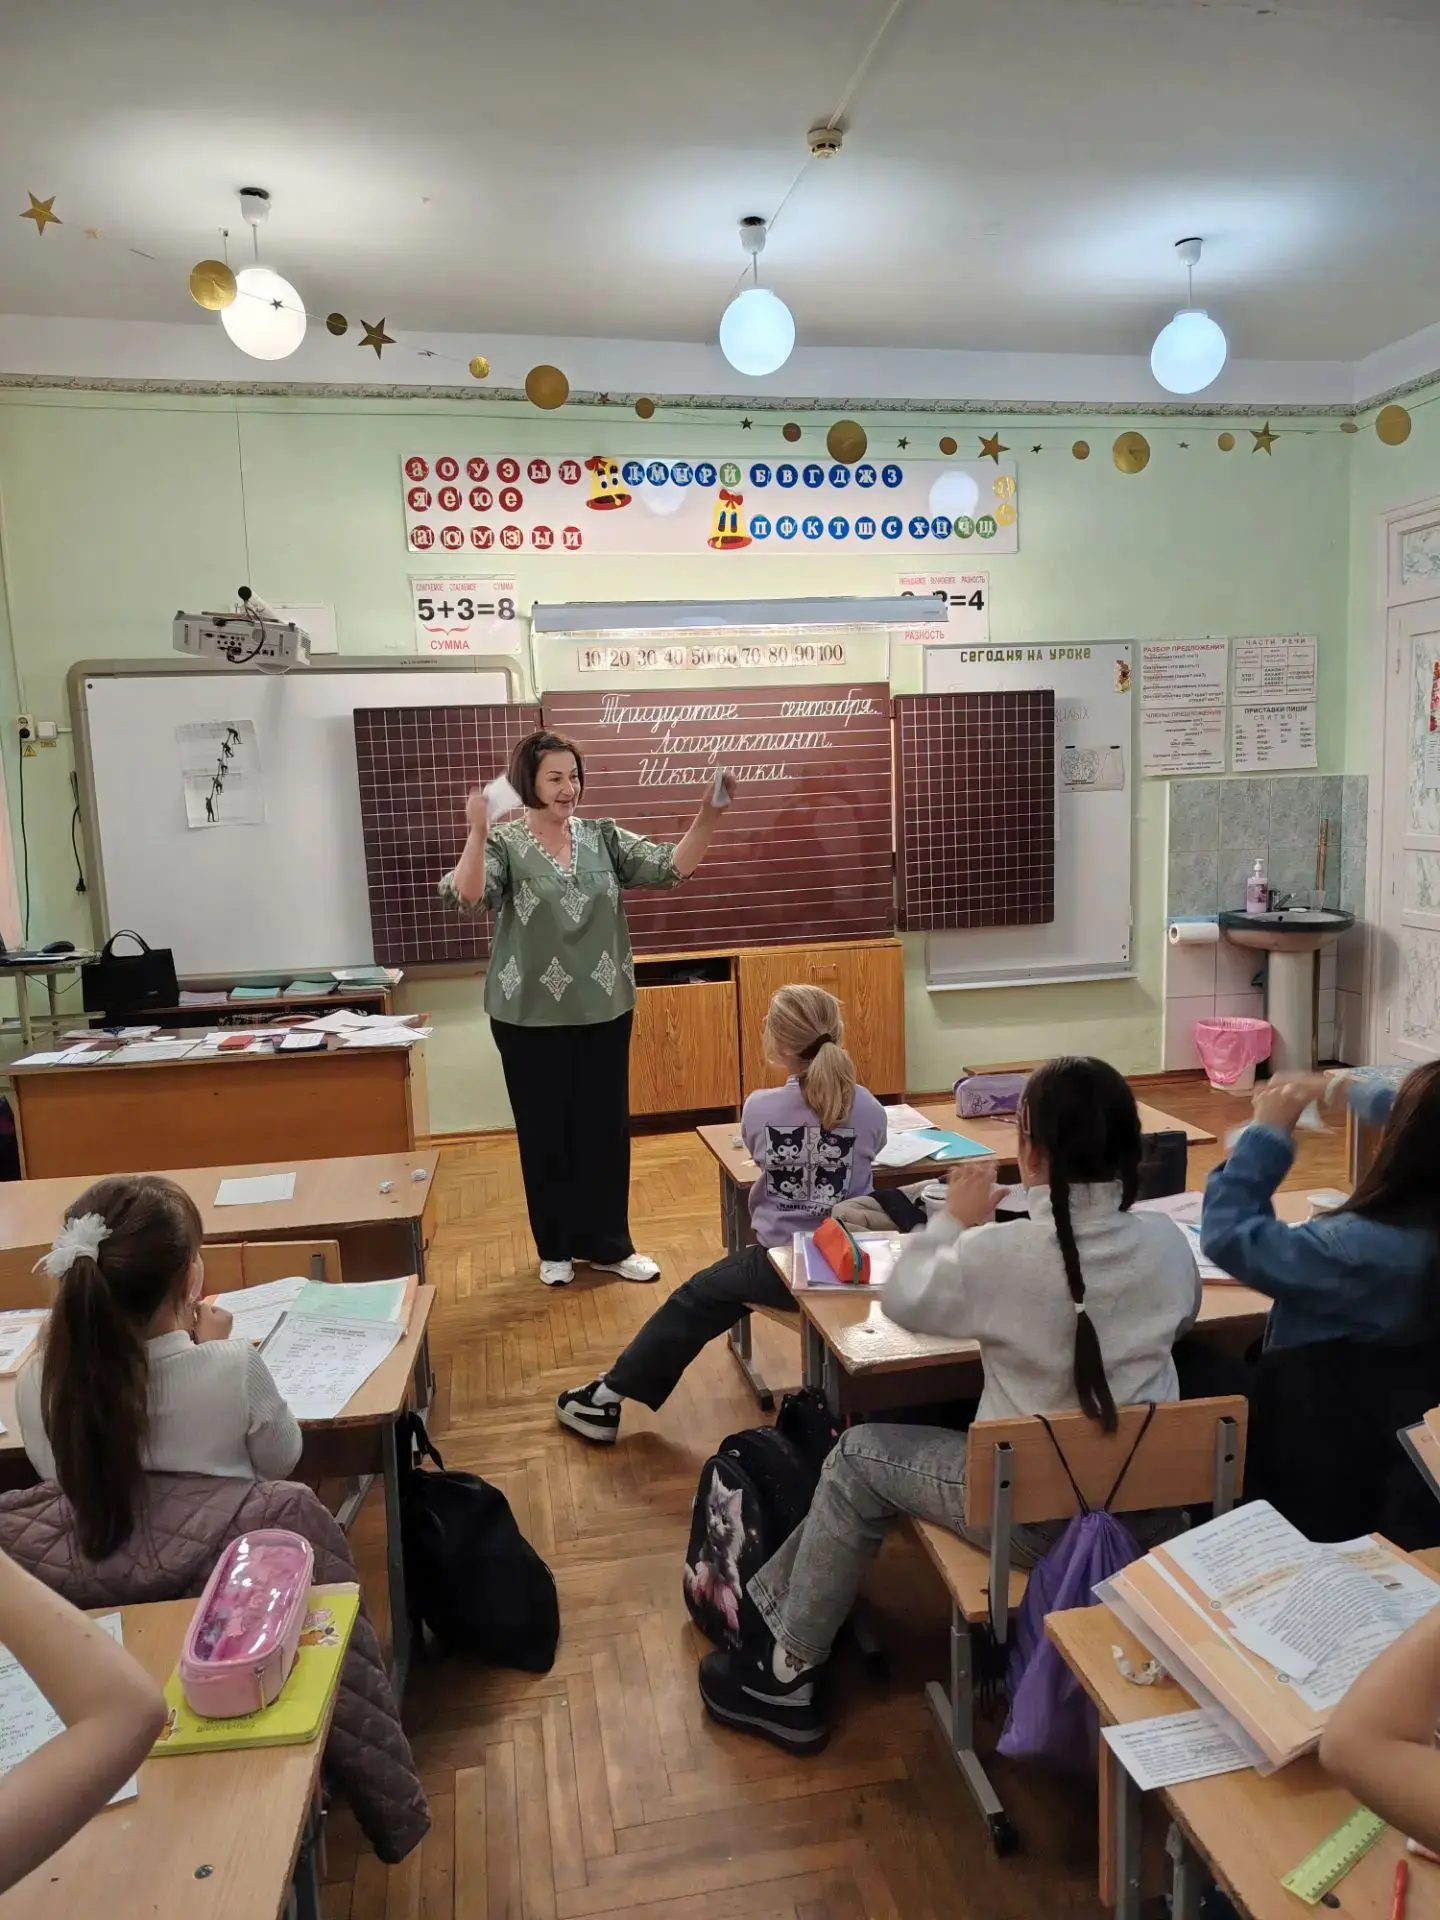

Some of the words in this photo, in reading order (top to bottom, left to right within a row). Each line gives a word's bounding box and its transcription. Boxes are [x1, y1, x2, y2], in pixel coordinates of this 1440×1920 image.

[418, 597, 516, 621] 5+3=8
[904, 630, 945, 640] РАЗНОСТЬ
[430, 640, 470, 650] СУММА
[1172, 644, 1225, 652] ПРЕДЛОЖЕНИЯ
[585, 651, 600, 667] 10
[610, 651, 630, 667] 20
[637, 650, 657, 666] 30
[664, 649, 684, 665] 40
[692, 649, 710, 665] 50
[717, 647, 737, 664] 60
[742, 647, 760, 664] 70
[769, 647, 788, 663] 80
[795, 645, 814, 661] 90
[819, 645, 843, 661] 100
[600, 693, 739, 733] Тридцатое
